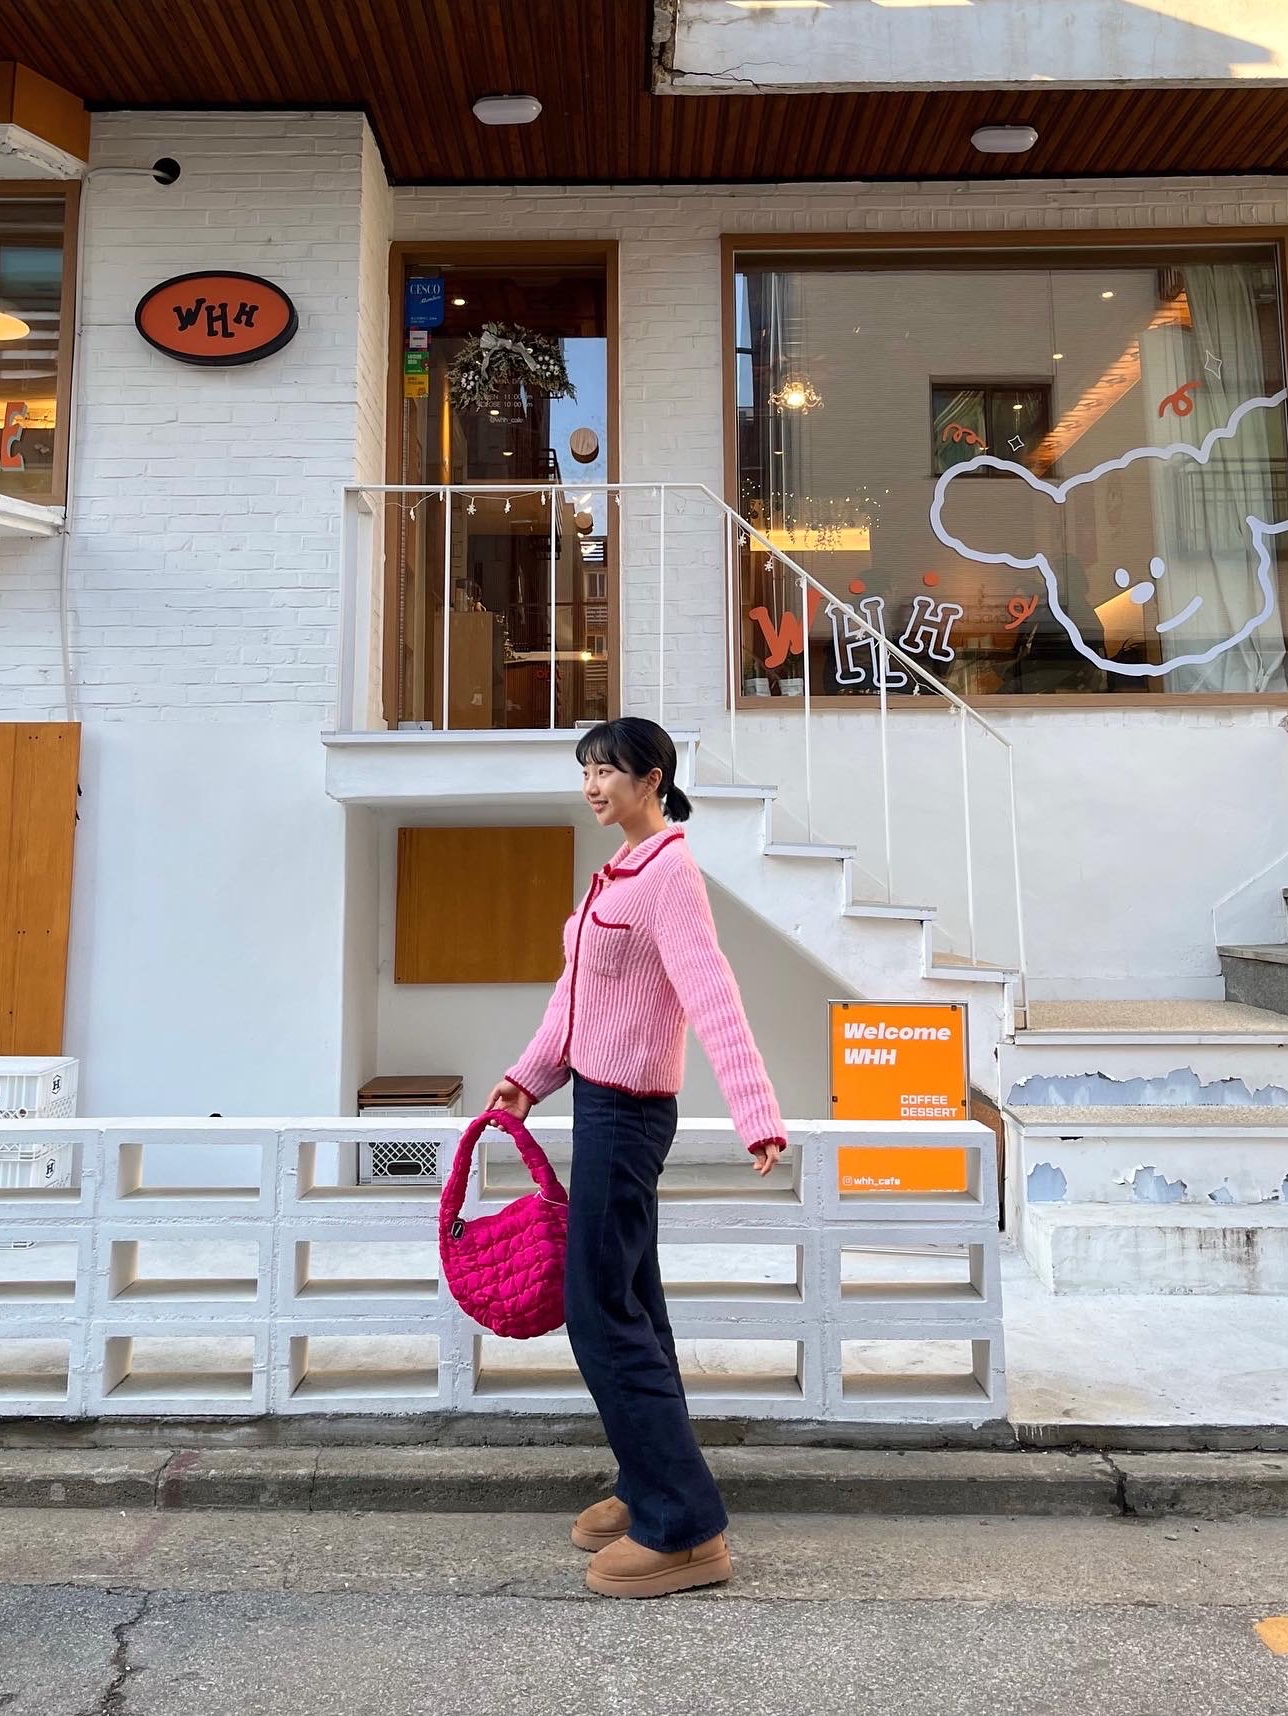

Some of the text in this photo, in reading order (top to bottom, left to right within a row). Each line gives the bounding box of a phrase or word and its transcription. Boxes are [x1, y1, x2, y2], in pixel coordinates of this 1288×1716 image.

[409, 283, 441, 295] CESCO
[172, 297, 260, 339] WHH
[843, 1022, 952, 1041] Welcome
[844, 1047, 897, 1066] WHH
[900, 1094, 949, 1105] COFFEE
[900, 1106, 958, 1118] DESSERT
[853, 1175, 901, 1186] whh_cafe
